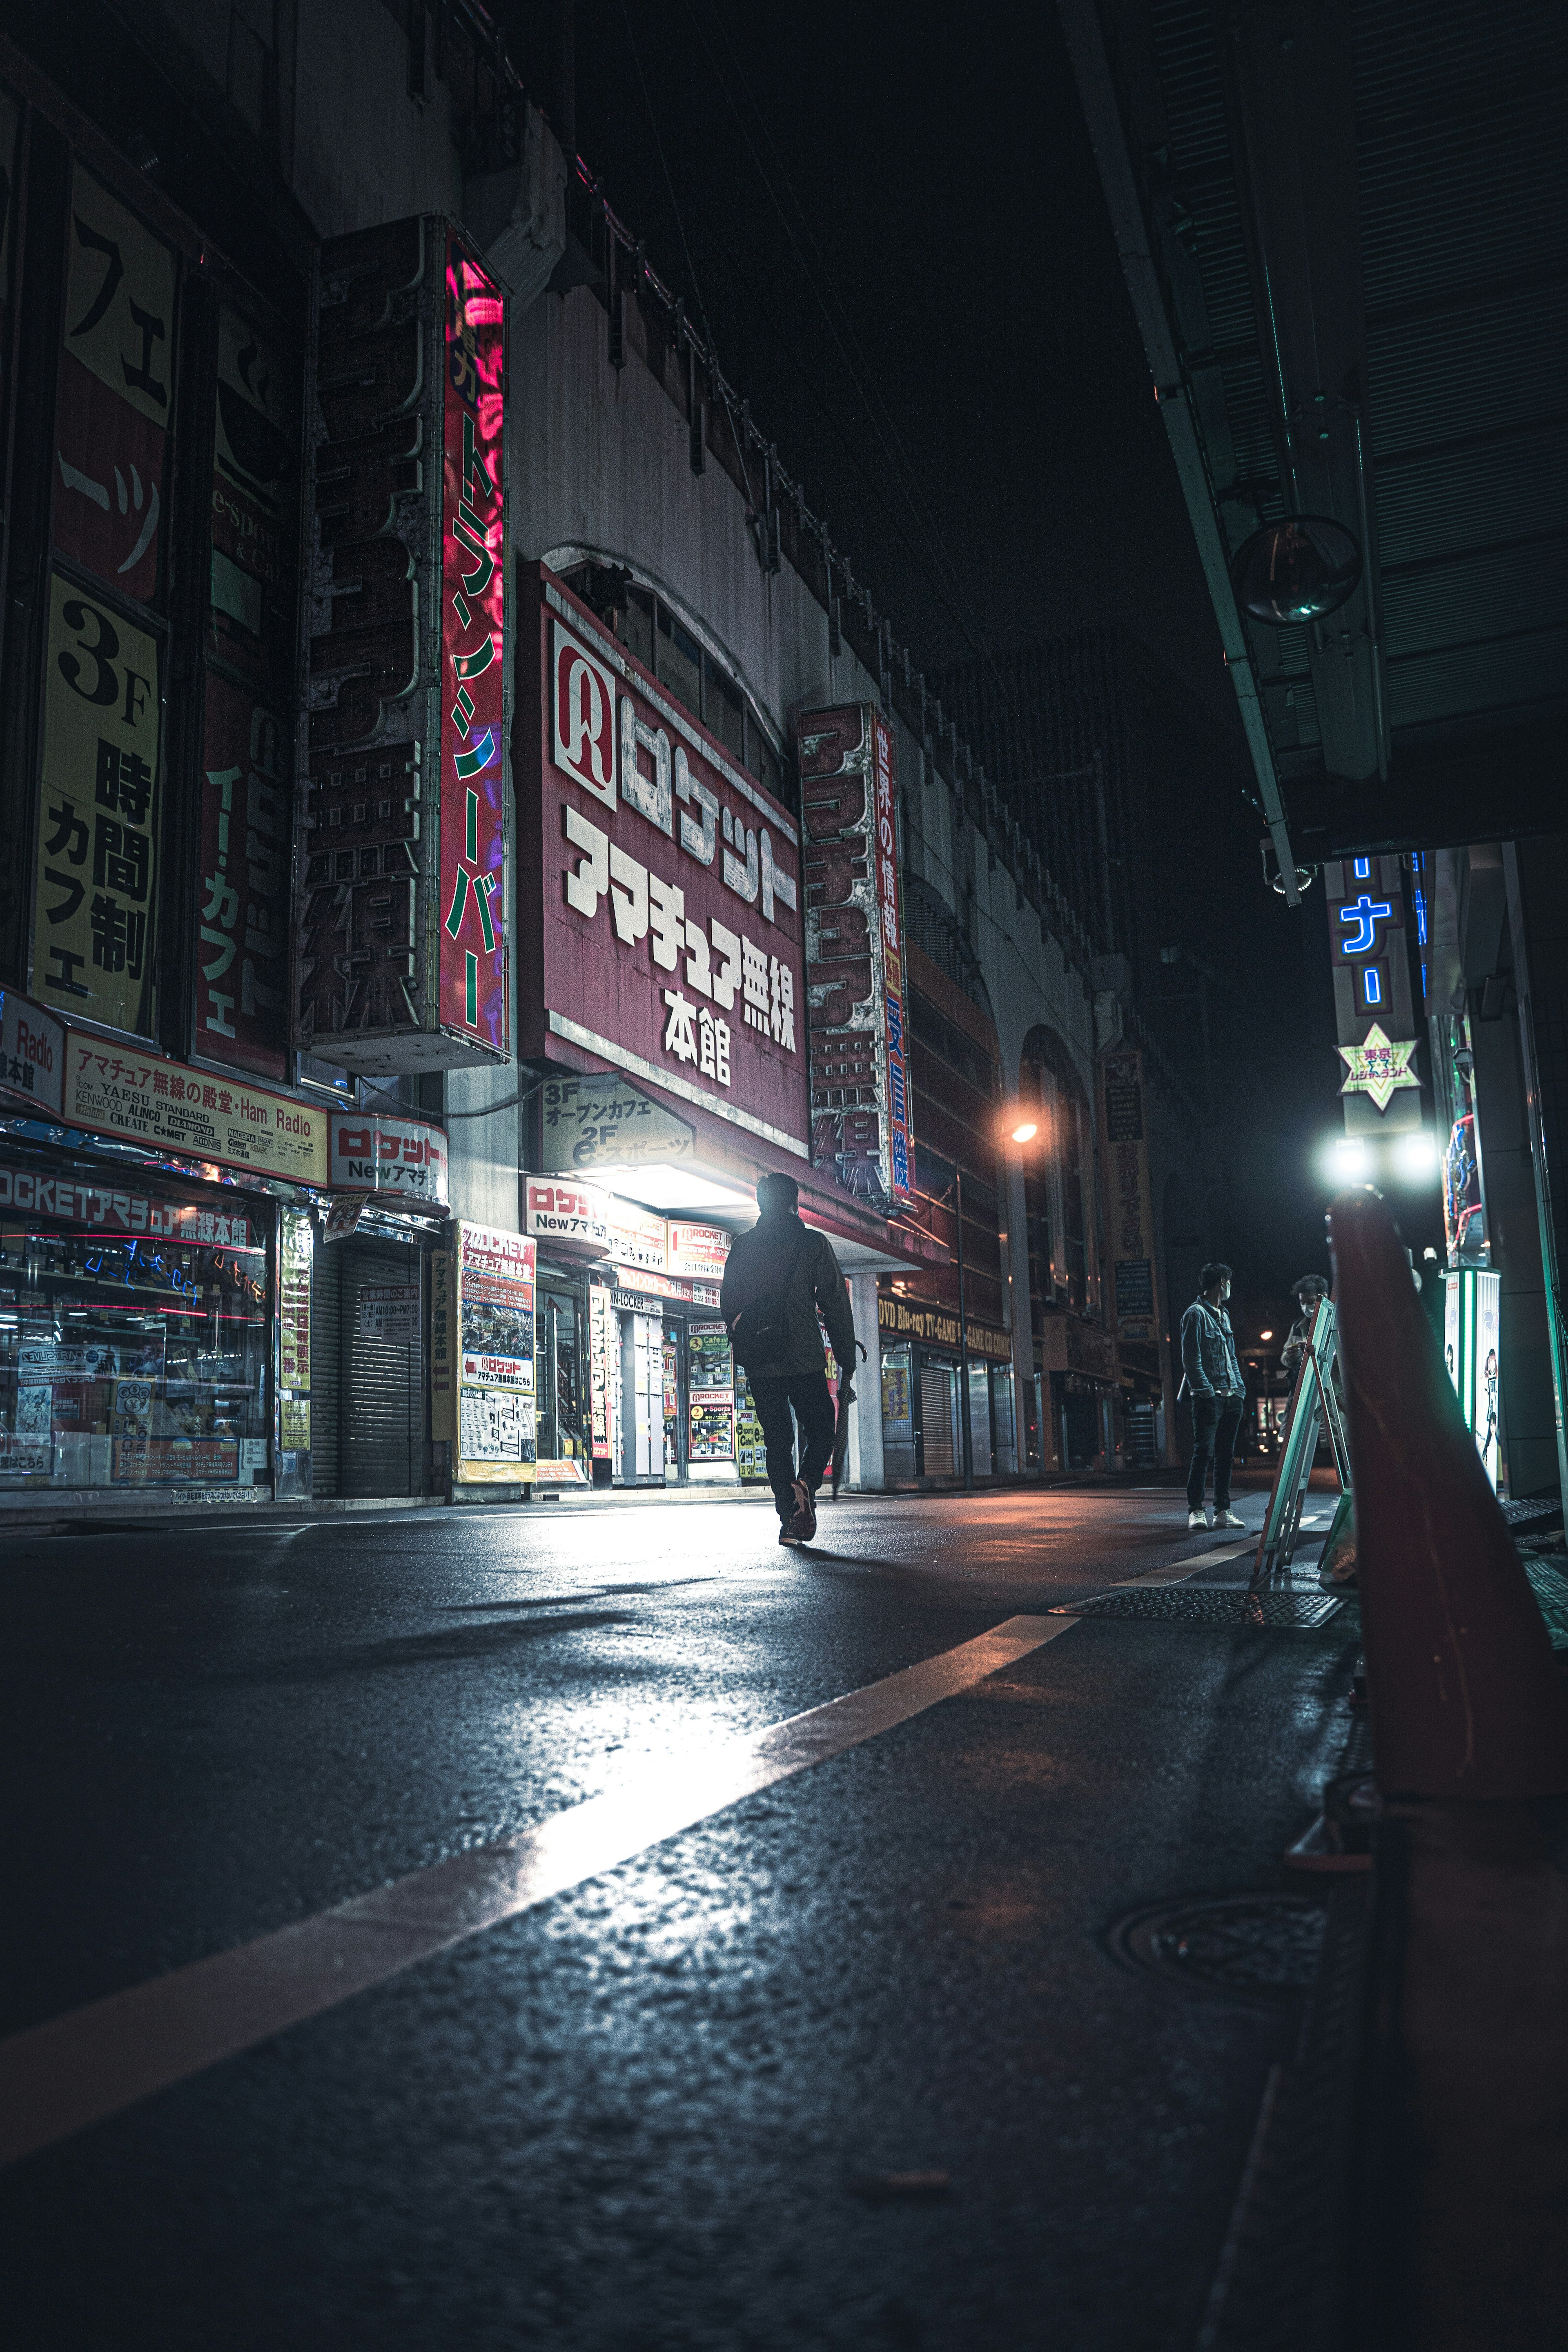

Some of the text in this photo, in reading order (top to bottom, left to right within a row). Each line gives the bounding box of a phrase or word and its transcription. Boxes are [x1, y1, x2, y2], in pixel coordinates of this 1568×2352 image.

[444, 411, 497, 1028] トランシーバー
[621, 696, 797, 924] ロケット
[91, 737, 151, 982] 時間制
[43, 800, 89, 1000] カフェ
[199, 764, 243, 1040] イー・カフェ
[566, 804, 796, 1054] アマチュア無線
[17, 1019, 53, 1073] Radio
[665, 988, 731, 1087] 本館
[1364, 1048, 1392, 1060] 東京
[1350, 1067, 1408, 1081] レジャーランド
[76, 1089, 122, 1112] KENWOOD
[100, 1083, 150, 1106] YAESU
[544, 1081, 580, 1106] 3F
[110, 1112, 149, 1133] CREATE
[128, 1104, 160, 1123] ALINCO
[156, 1101, 209, 1123] STANDARD
[276, 1108, 311, 1137] Radio
[546, 1100, 652, 1127] オープンカフェ
[170, 1116, 214, 1136] DIAMOND
[581, 1125, 618, 1145] 2F
[227, 1147, 249, 1159] ミズホ通信
[339, 1127, 440, 1166] ロケット
[693, 1228, 722, 1241] ROCKET
[693, 1285, 702, 1293] OPEN
[693, 1294, 704, 1303] CLOSE
[434, 1258, 448, 1360] アマチュア無線本館
[878, 1298, 896, 1328] DVD
[897, 1304, 924, 1337] Blu-ray
[925, 1312, 956, 1343] TV-GAME
[375, 1318, 382, 1327] AM
[488, 1358, 521, 1375] ロケット
